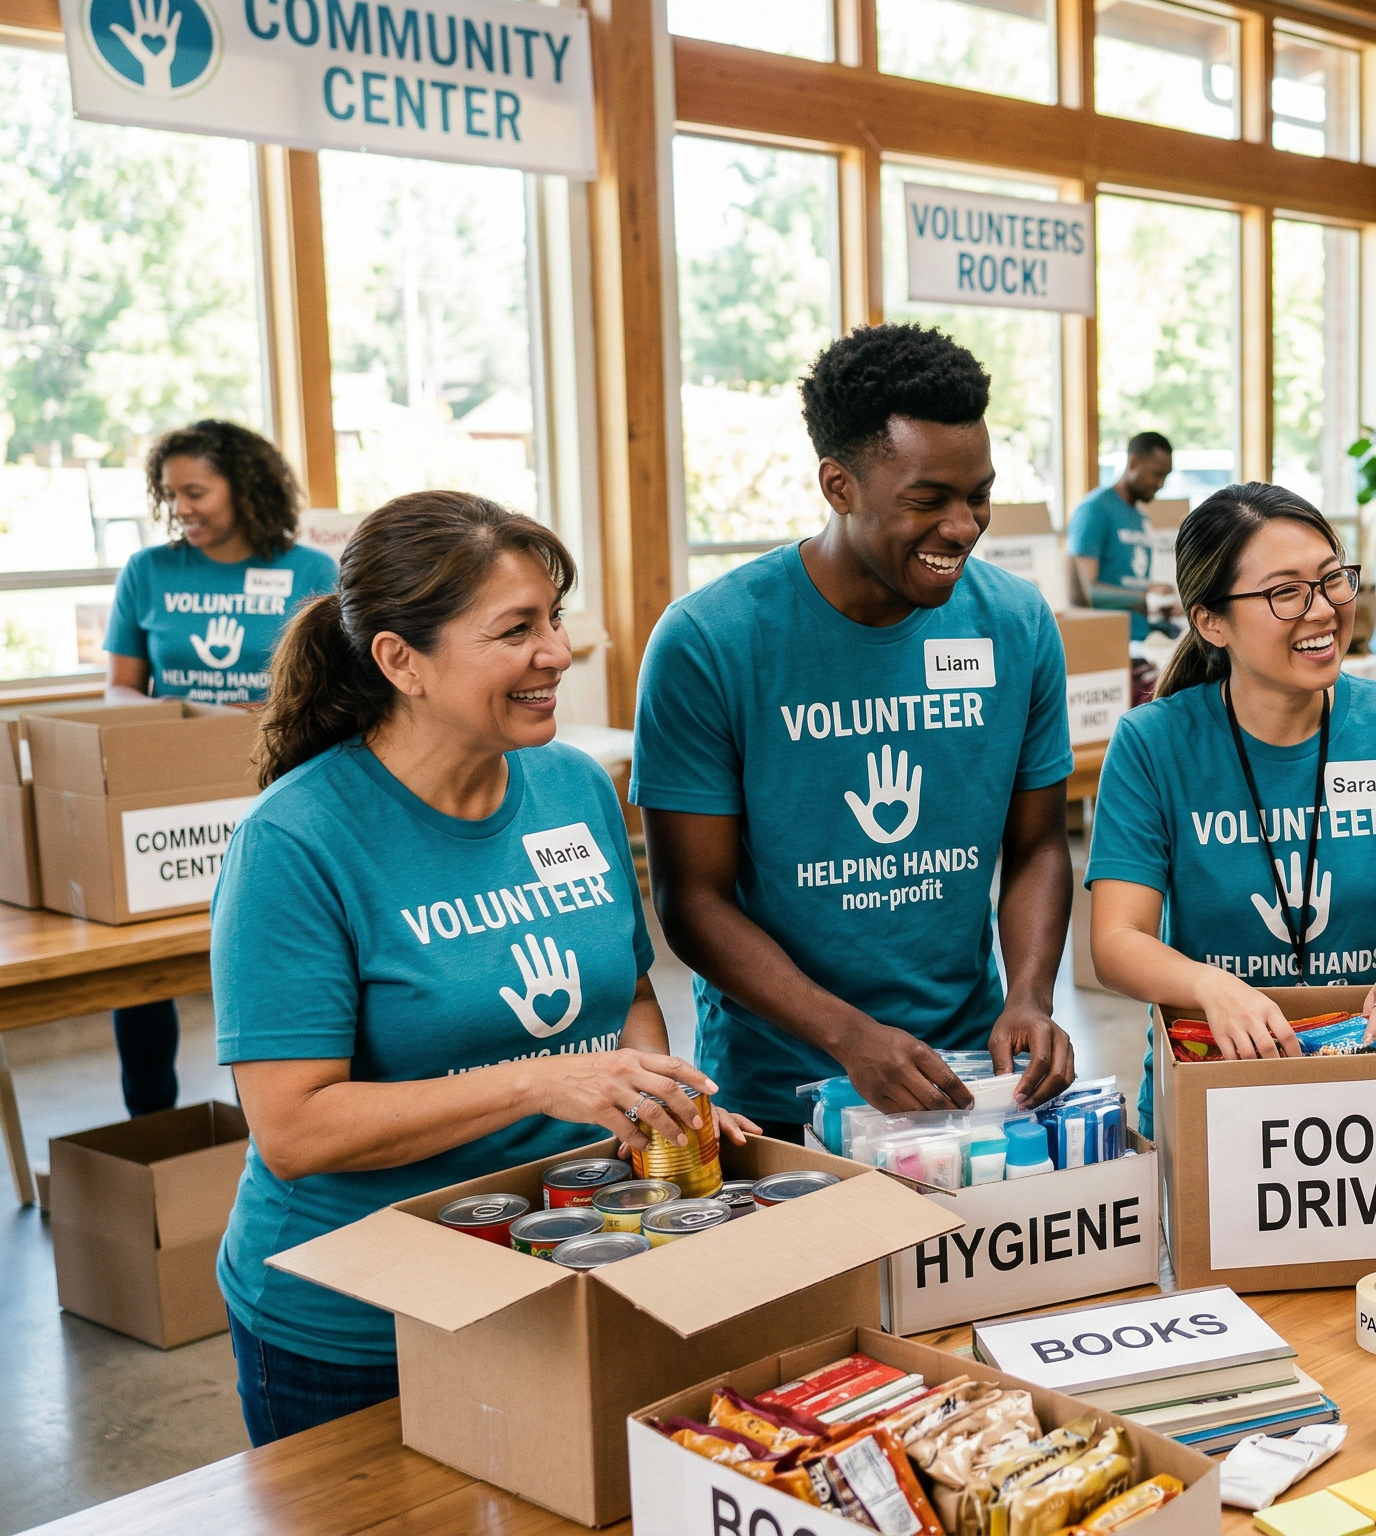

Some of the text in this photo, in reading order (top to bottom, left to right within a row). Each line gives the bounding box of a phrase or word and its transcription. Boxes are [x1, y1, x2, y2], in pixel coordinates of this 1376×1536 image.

[244, 0, 571, 84] COMMUNITY
[323, 66, 521, 142] CENTER
[911, 202, 1085, 255] VOLUNTEERS
[957, 252, 1048, 297] ROCK!
[164, 592, 286, 616] VOLUNTEER
[162, 669, 272, 689] HELPING HAND
[935, 655, 980, 671] Liam
[780, 692, 985, 741] VOLUNTEER
[160, 854, 224, 881] CENT
[536, 842, 591, 868] Maria
[797, 845, 979, 887] HELPING HANDS
[400, 874, 614, 945] VOLUNTEER
[842, 878, 943, 911] non-profit
[915, 1196, 1141, 1289] HYGIENE
[1030, 1313, 1228, 1364] BOOKS
